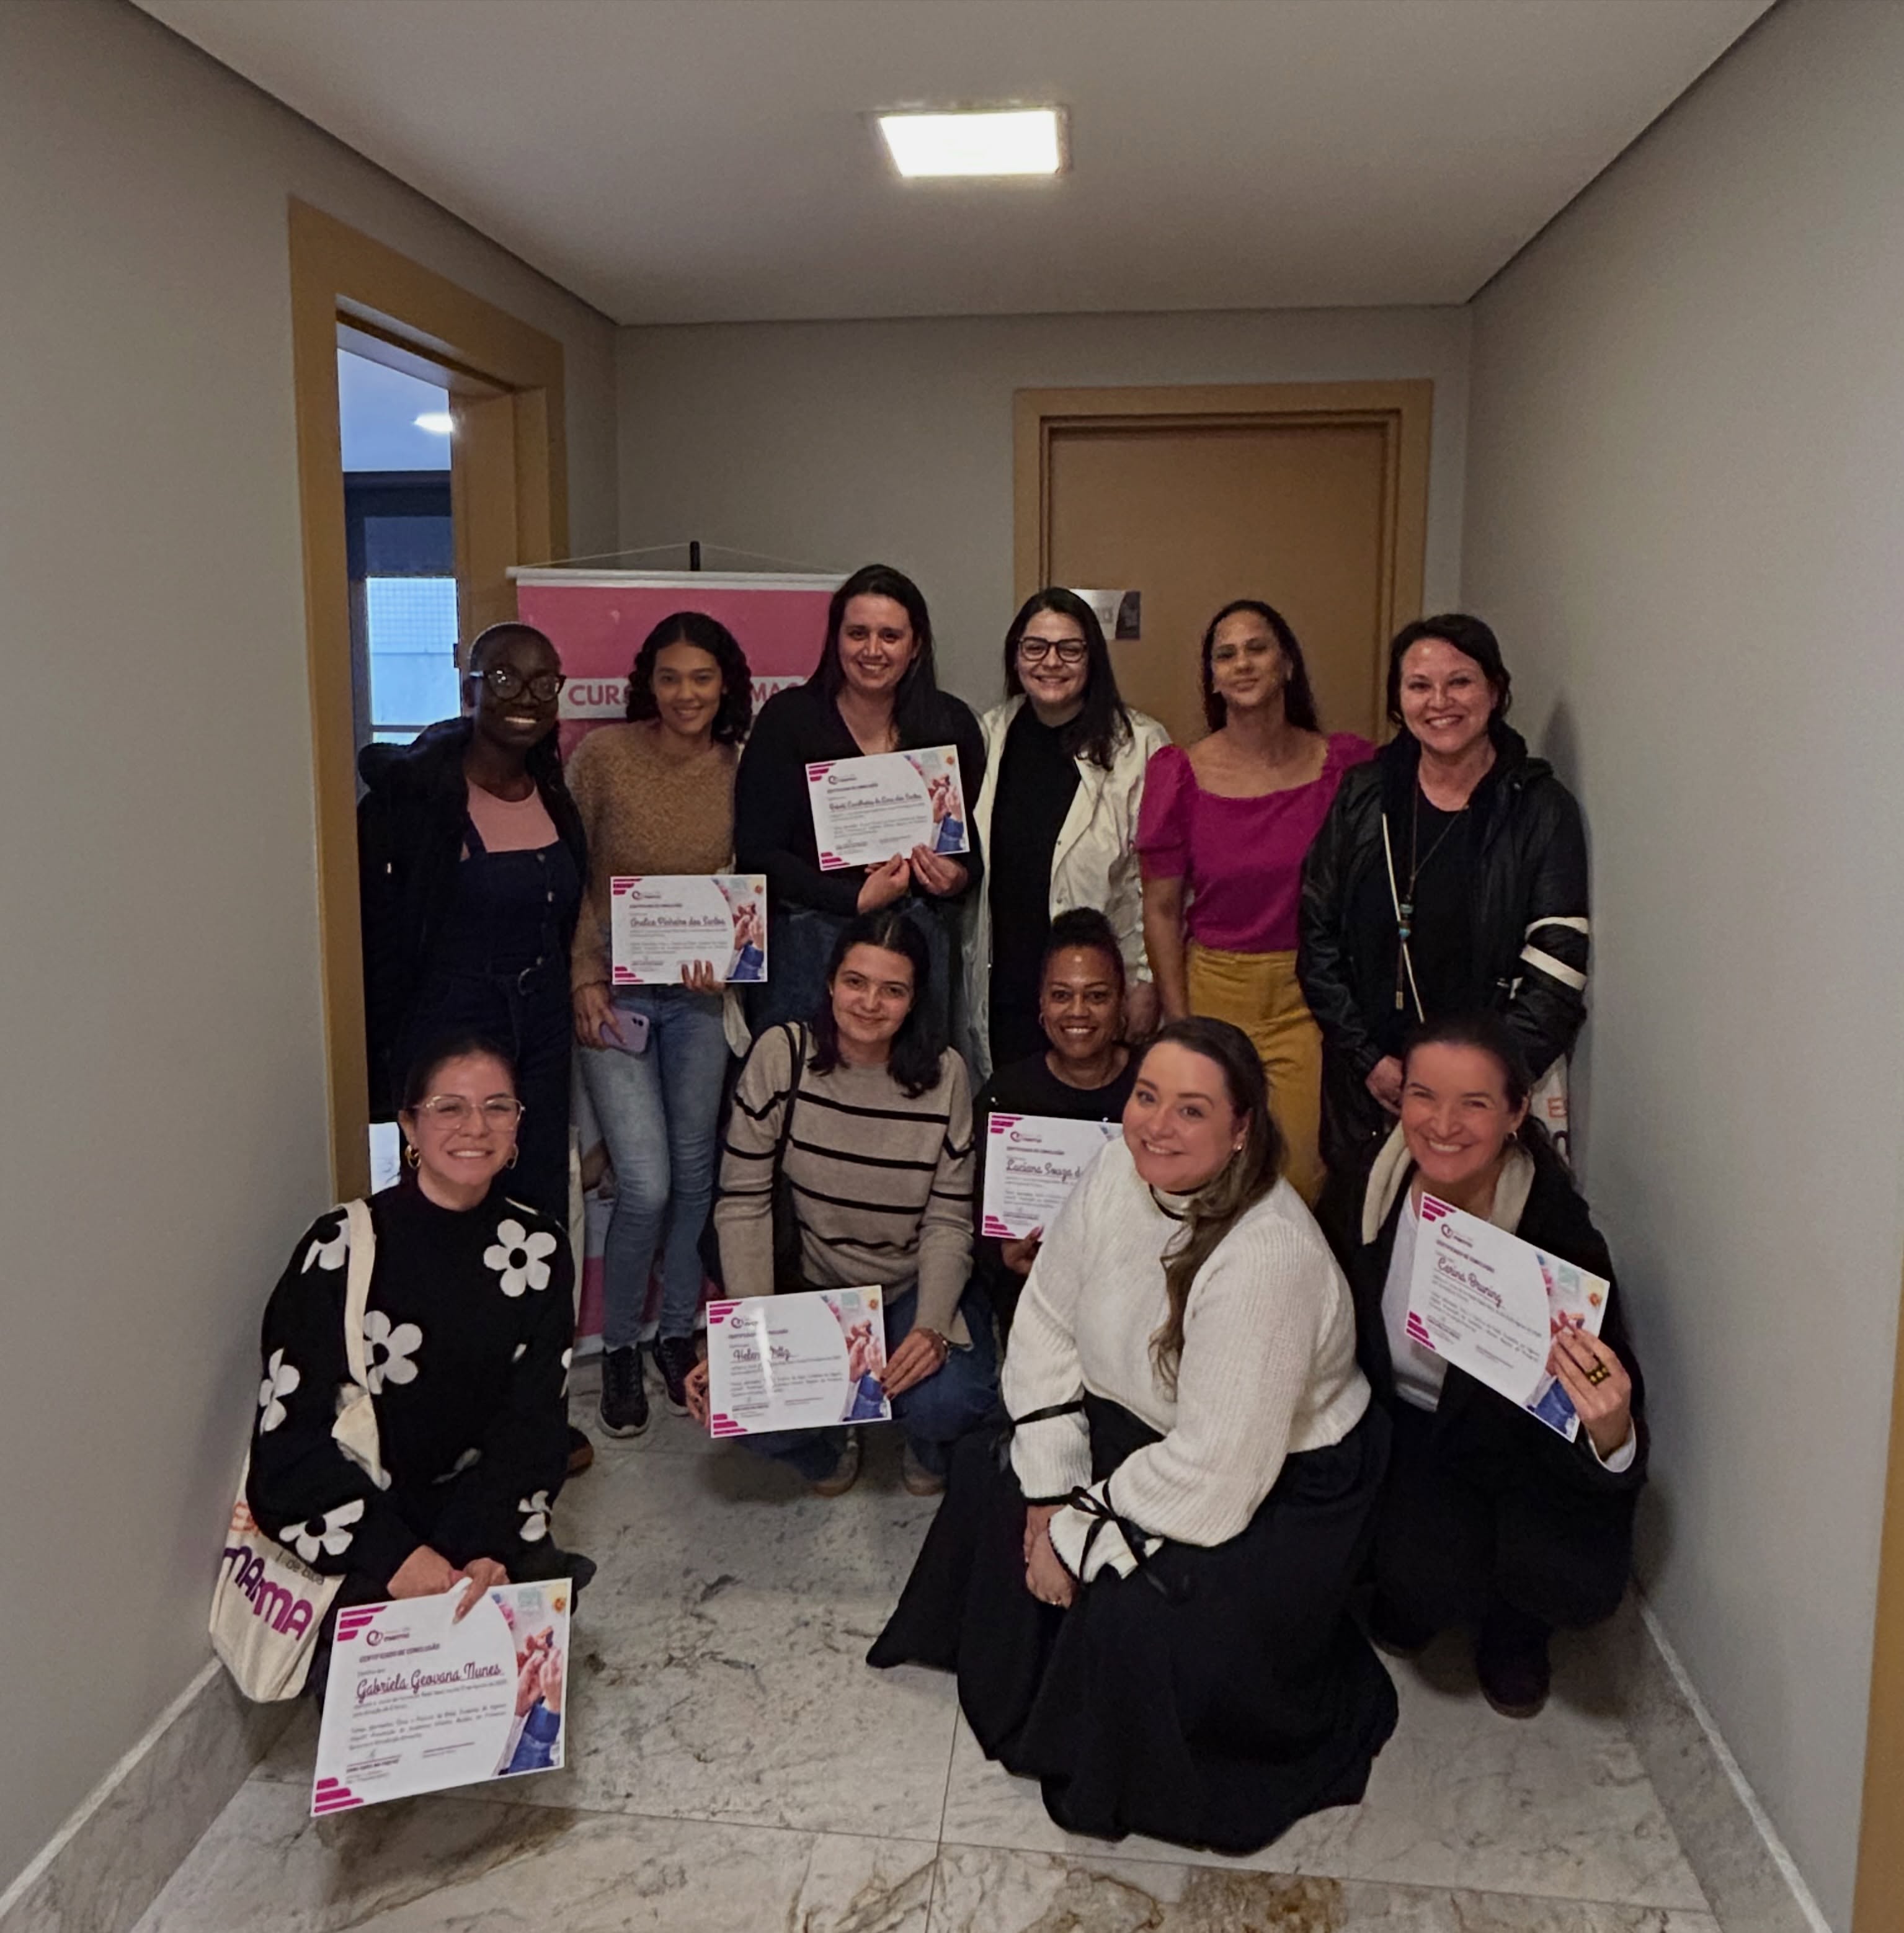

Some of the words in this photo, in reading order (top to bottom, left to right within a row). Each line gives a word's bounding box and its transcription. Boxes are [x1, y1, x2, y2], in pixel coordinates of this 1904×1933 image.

[357, 1673, 409, 1704] Gabriela
[411, 1669, 461, 1694] Geovana
[463, 1661, 502, 1679] Nunes
